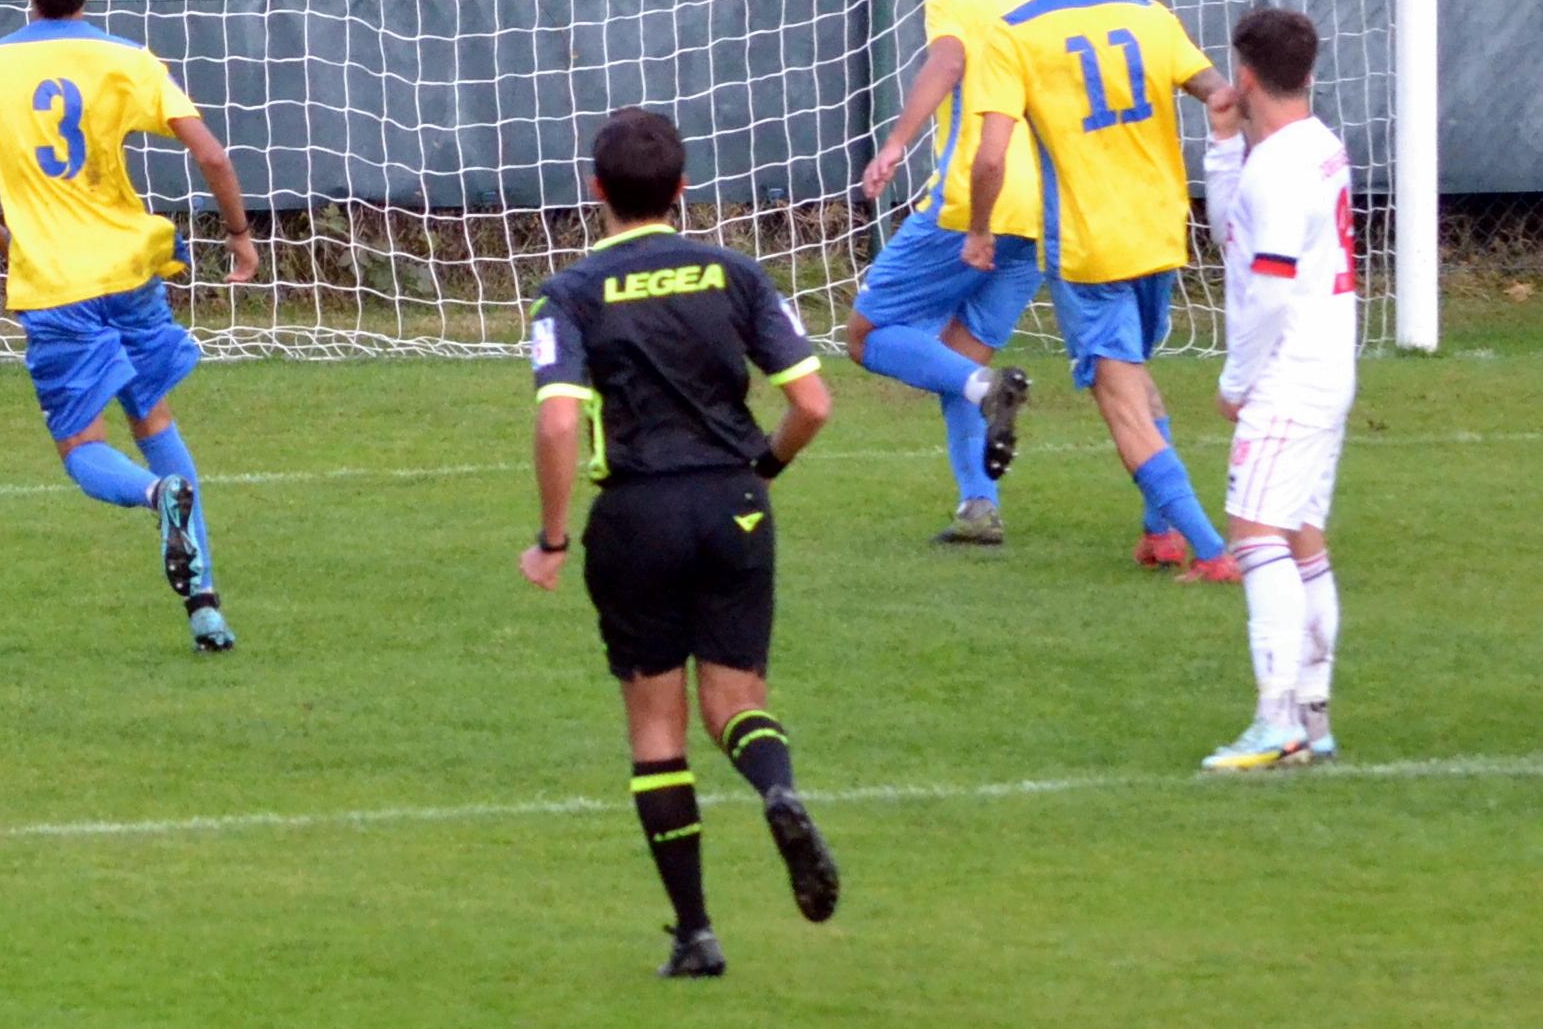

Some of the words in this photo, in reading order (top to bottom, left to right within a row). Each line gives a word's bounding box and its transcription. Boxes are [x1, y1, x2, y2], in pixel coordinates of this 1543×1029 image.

[32, 77, 87, 180] 3
[1066, 28, 1153, 133] 11
[604, 263, 726, 303] LEGEA
